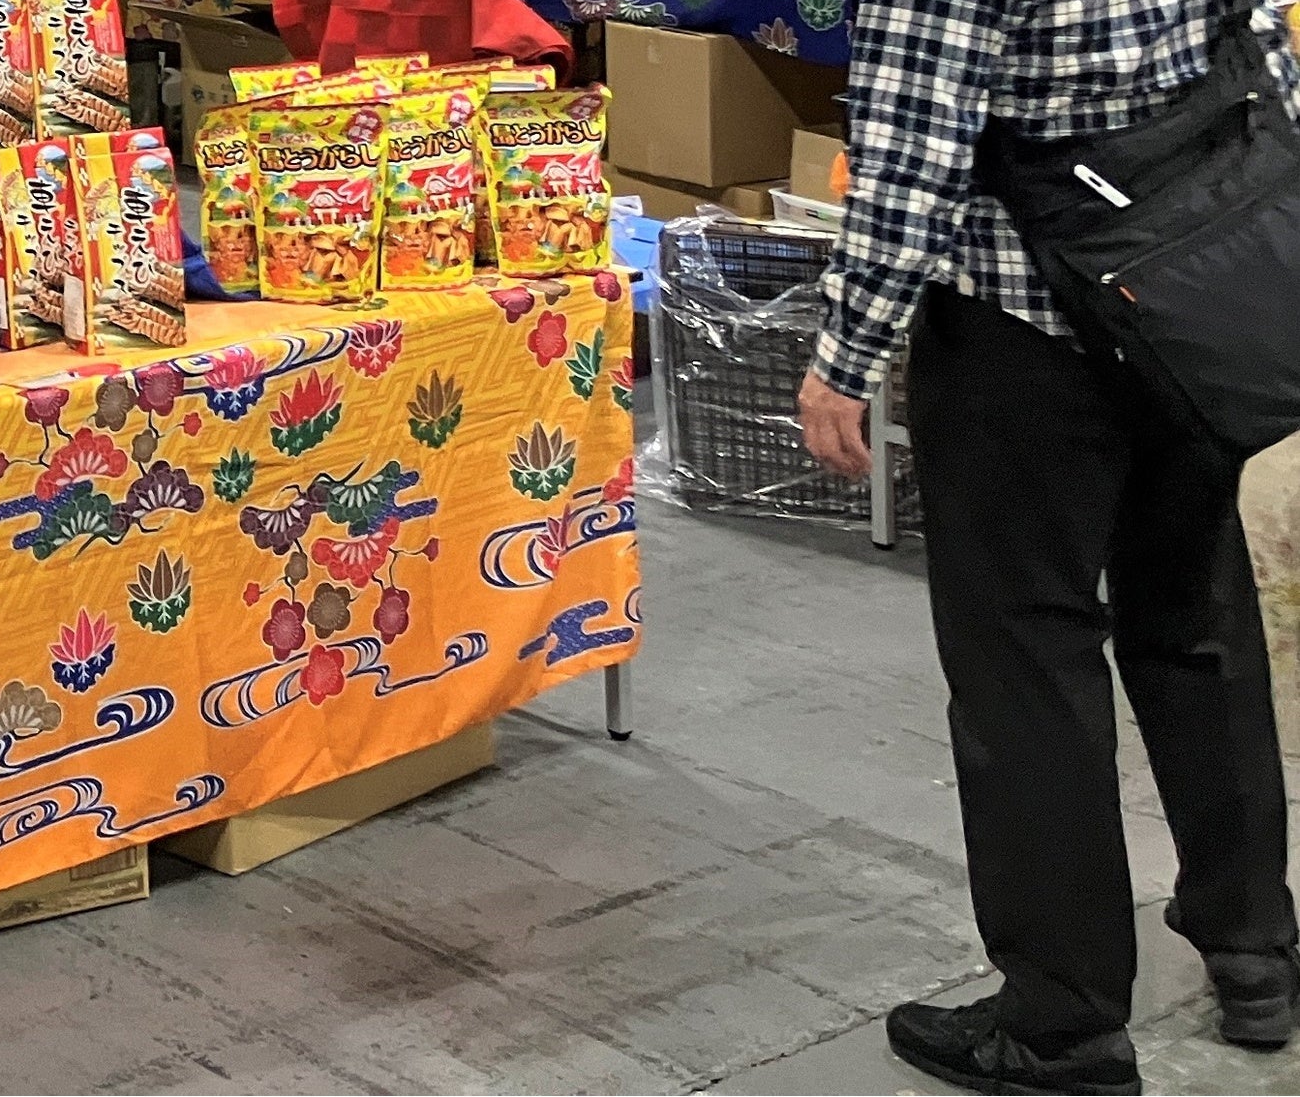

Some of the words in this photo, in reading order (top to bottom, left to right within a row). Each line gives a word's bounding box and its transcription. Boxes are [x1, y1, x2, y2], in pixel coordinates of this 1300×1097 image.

[490, 119, 601, 148] 島とうがらし
[258, 143, 379, 172] 島とうがらし
